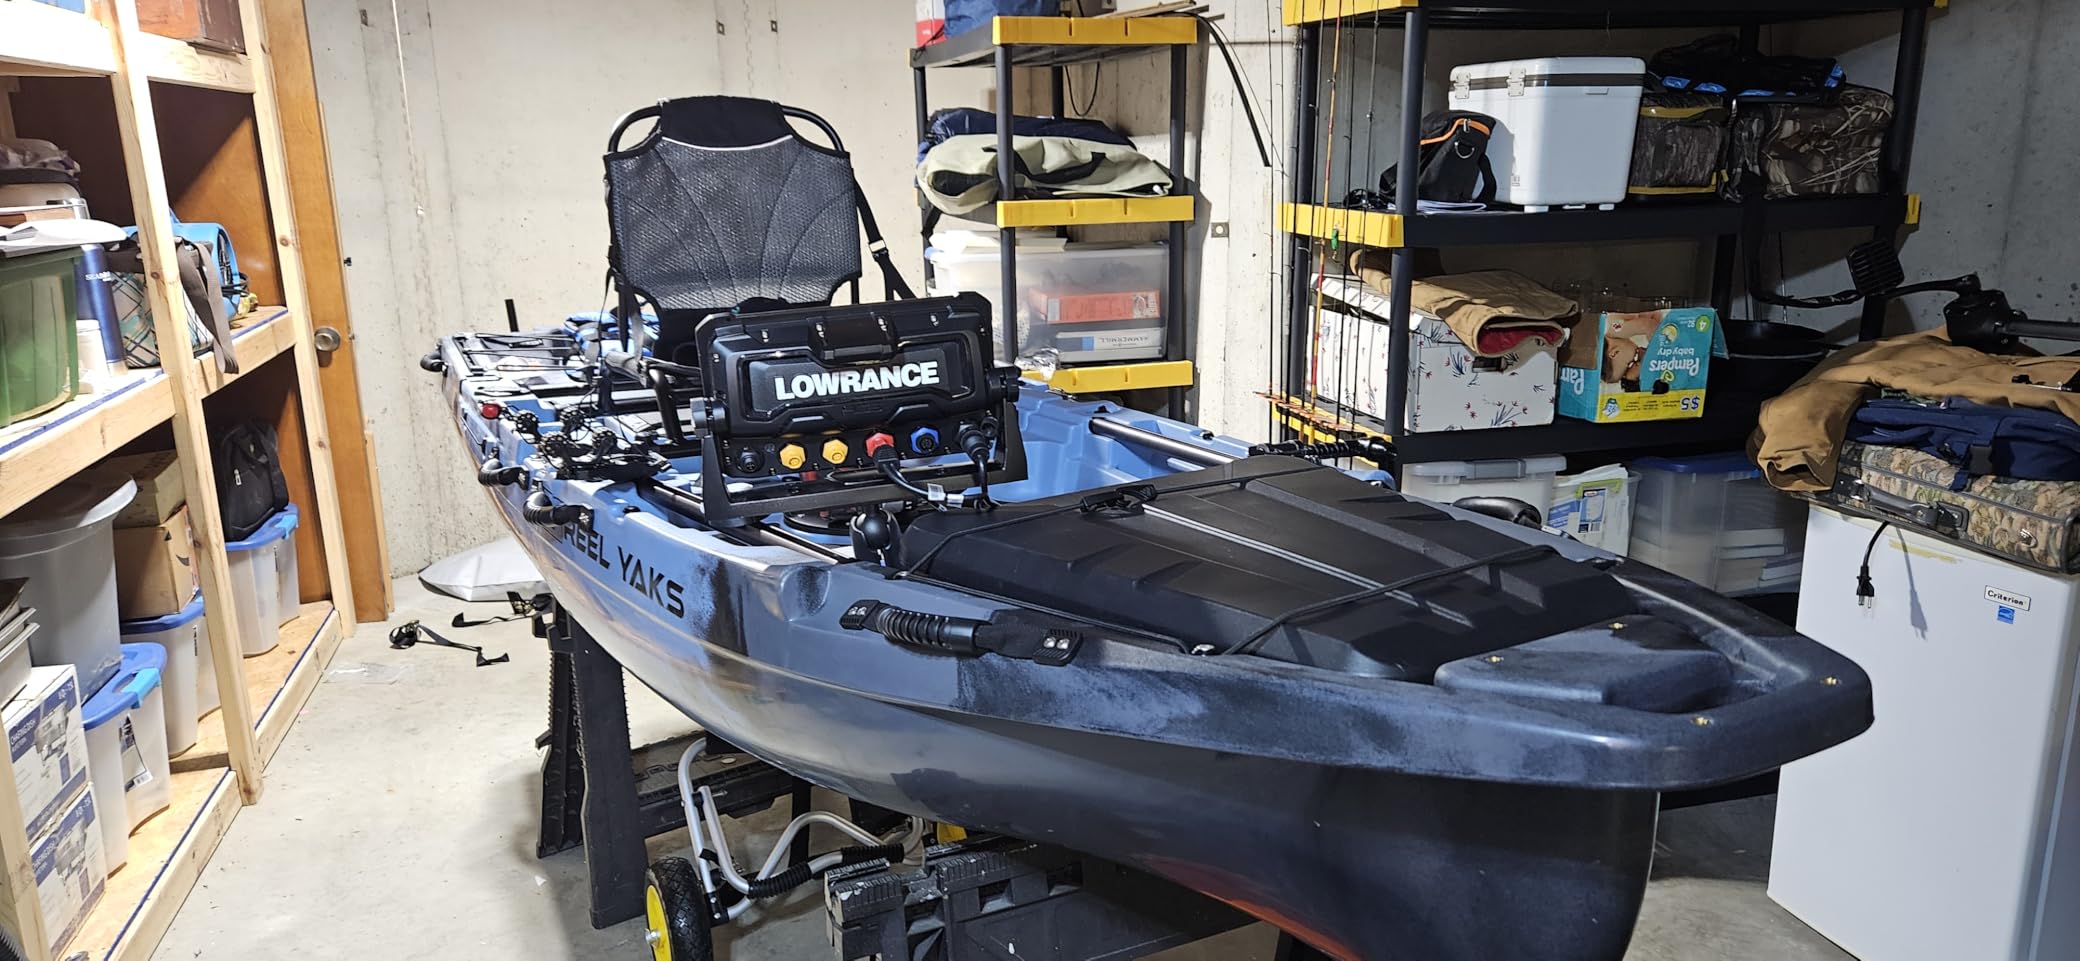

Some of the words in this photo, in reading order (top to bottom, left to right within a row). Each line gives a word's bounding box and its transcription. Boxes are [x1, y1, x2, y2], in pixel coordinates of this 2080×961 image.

[1700, 320, 1707, 331] 4
[1657, 347, 1672, 357] dry
[1672, 347, 1695, 356] baby
[1649, 356, 1700, 376] Pampers
[774, 361, 940, 400] LOWRANCE
[1681, 396, 1700, 410] $5
[564, 523, 610, 569] REEL
[617, 545, 685, 619] YAKS
[1987, 590, 2024, 606] Criterion
